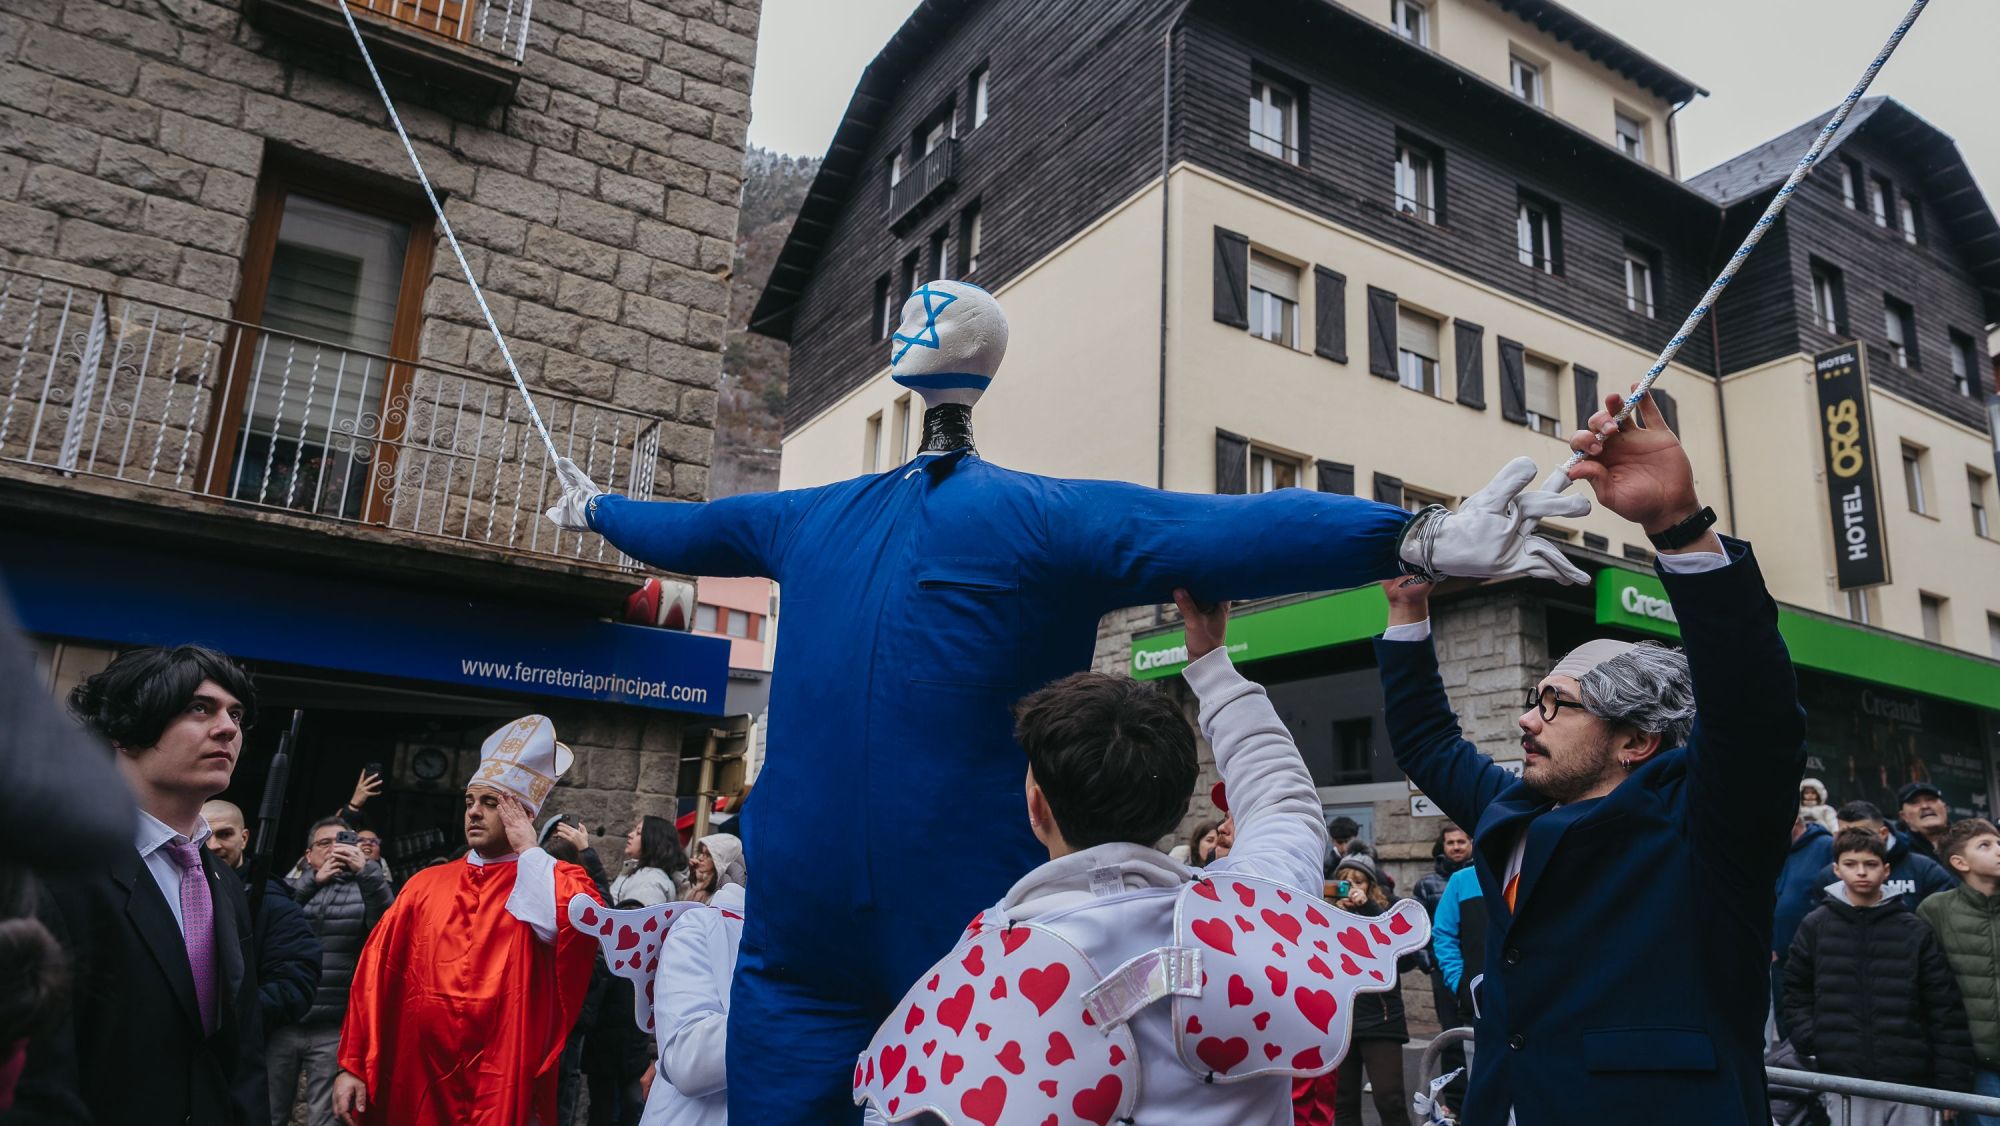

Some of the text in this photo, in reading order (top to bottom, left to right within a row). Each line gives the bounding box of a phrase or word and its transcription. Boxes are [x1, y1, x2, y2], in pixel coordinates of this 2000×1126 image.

[1817, 353, 1855, 371] HOTEL
[1842, 485, 1868, 560] HOTEL
[461, 658, 707, 704] www.ferreteriaprincipat.com
[1861, 688, 1921, 725] Creand
